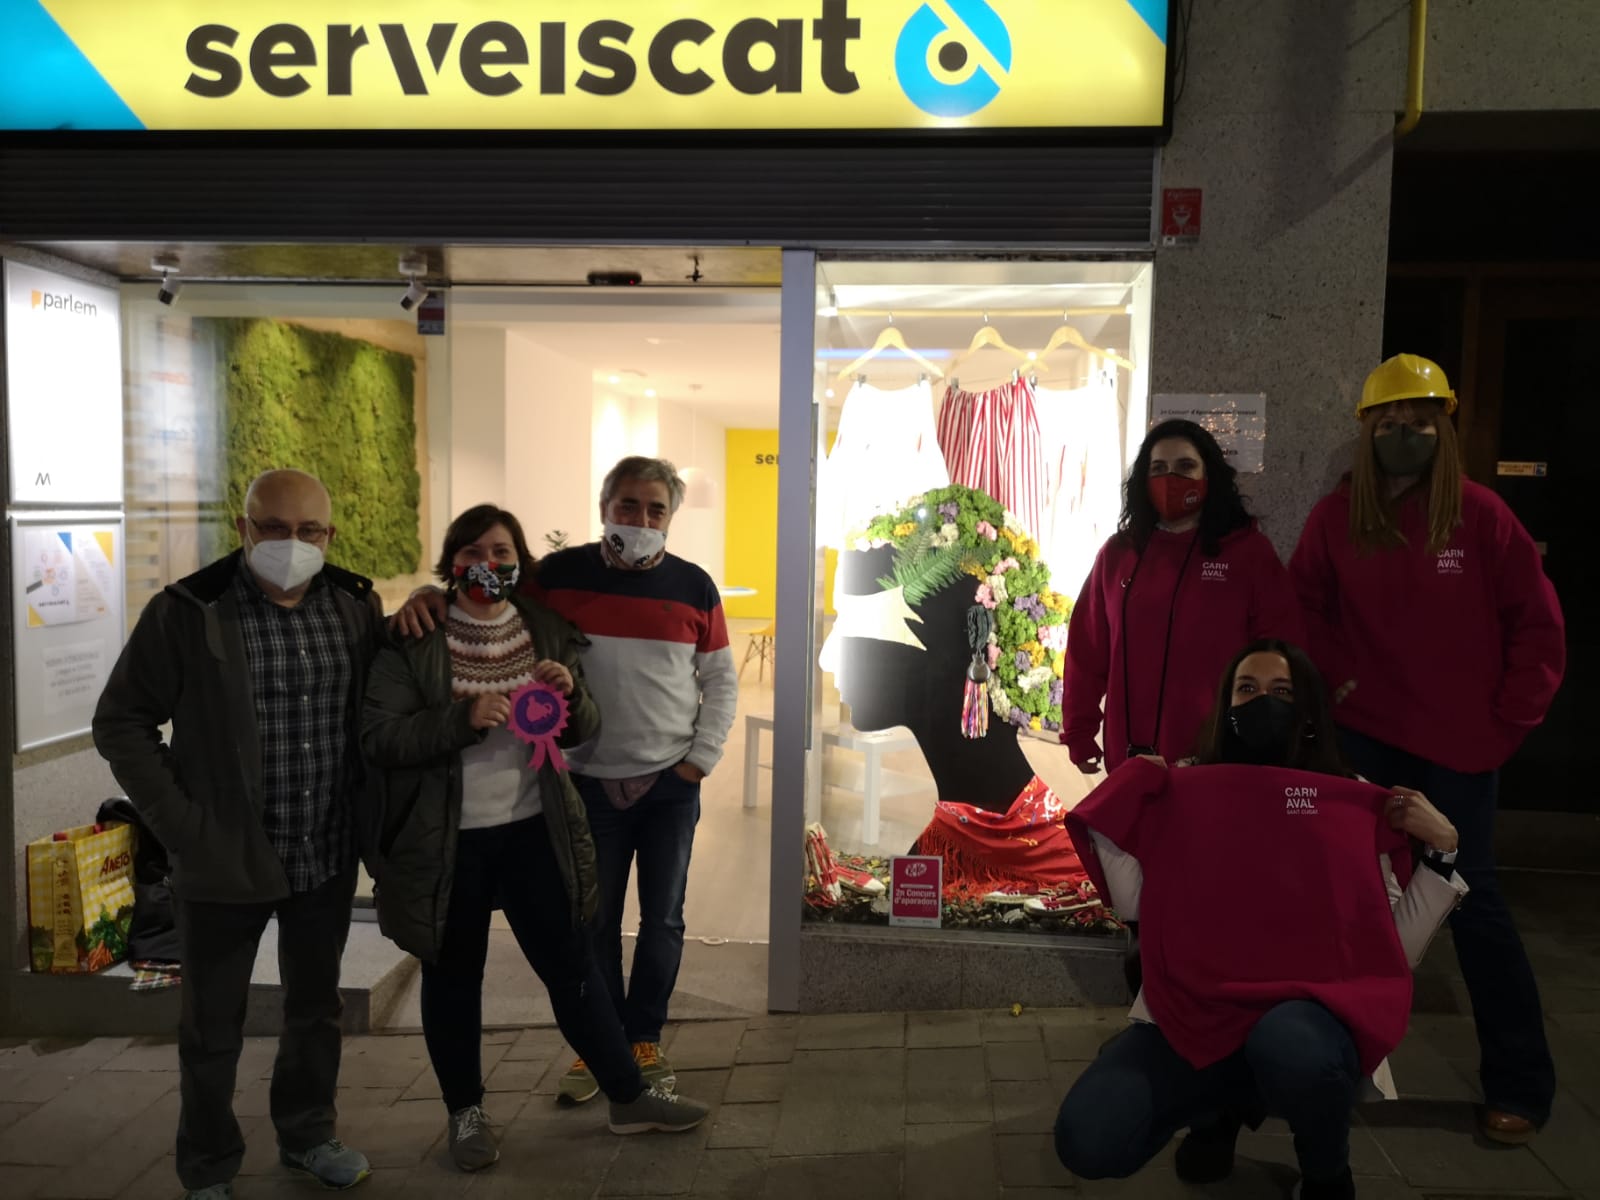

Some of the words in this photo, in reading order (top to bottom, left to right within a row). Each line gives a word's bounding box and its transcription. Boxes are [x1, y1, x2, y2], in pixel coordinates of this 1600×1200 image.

[185, 0, 861, 98] serveiscat
[43, 291, 97, 317] parlem
[1202, 562, 1228, 570] CARN
[1437, 559, 1462, 569] AVAL
[1201, 569, 1225, 577] AVAL
[1285, 787, 1317, 797] CARN
[1286, 798, 1315, 808] AVAL
[896, 889, 905, 897] 2n
[906, 889, 936, 898] Concurs
[894, 897, 938, 906] d'aparadors
